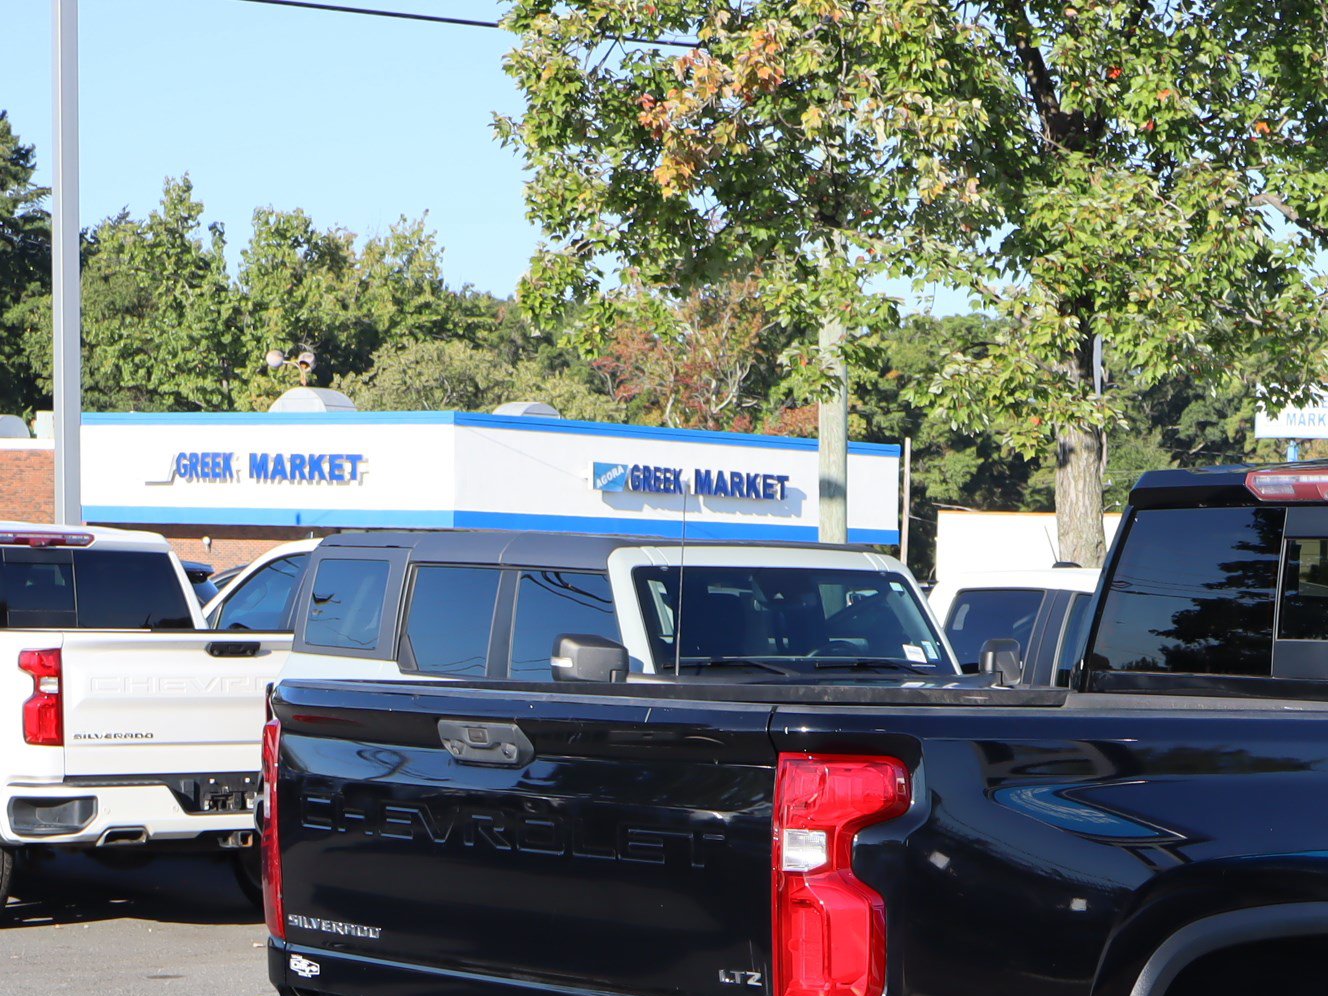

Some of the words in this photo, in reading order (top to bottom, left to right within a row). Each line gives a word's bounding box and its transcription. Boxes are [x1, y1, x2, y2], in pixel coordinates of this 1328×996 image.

[176, 452, 234, 479] GREEK
[249, 452, 363, 481] MARKET
[595, 464, 625, 489] AGORA
[631, 463, 683, 494] GREEK
[694, 468, 790, 501] MARKET
[73, 732, 154, 740] SILVERADO
[299, 792, 726, 868] CHEVROLET
[287, 913, 382, 939] SILVERADO
[719, 969, 763, 987] LTZ
